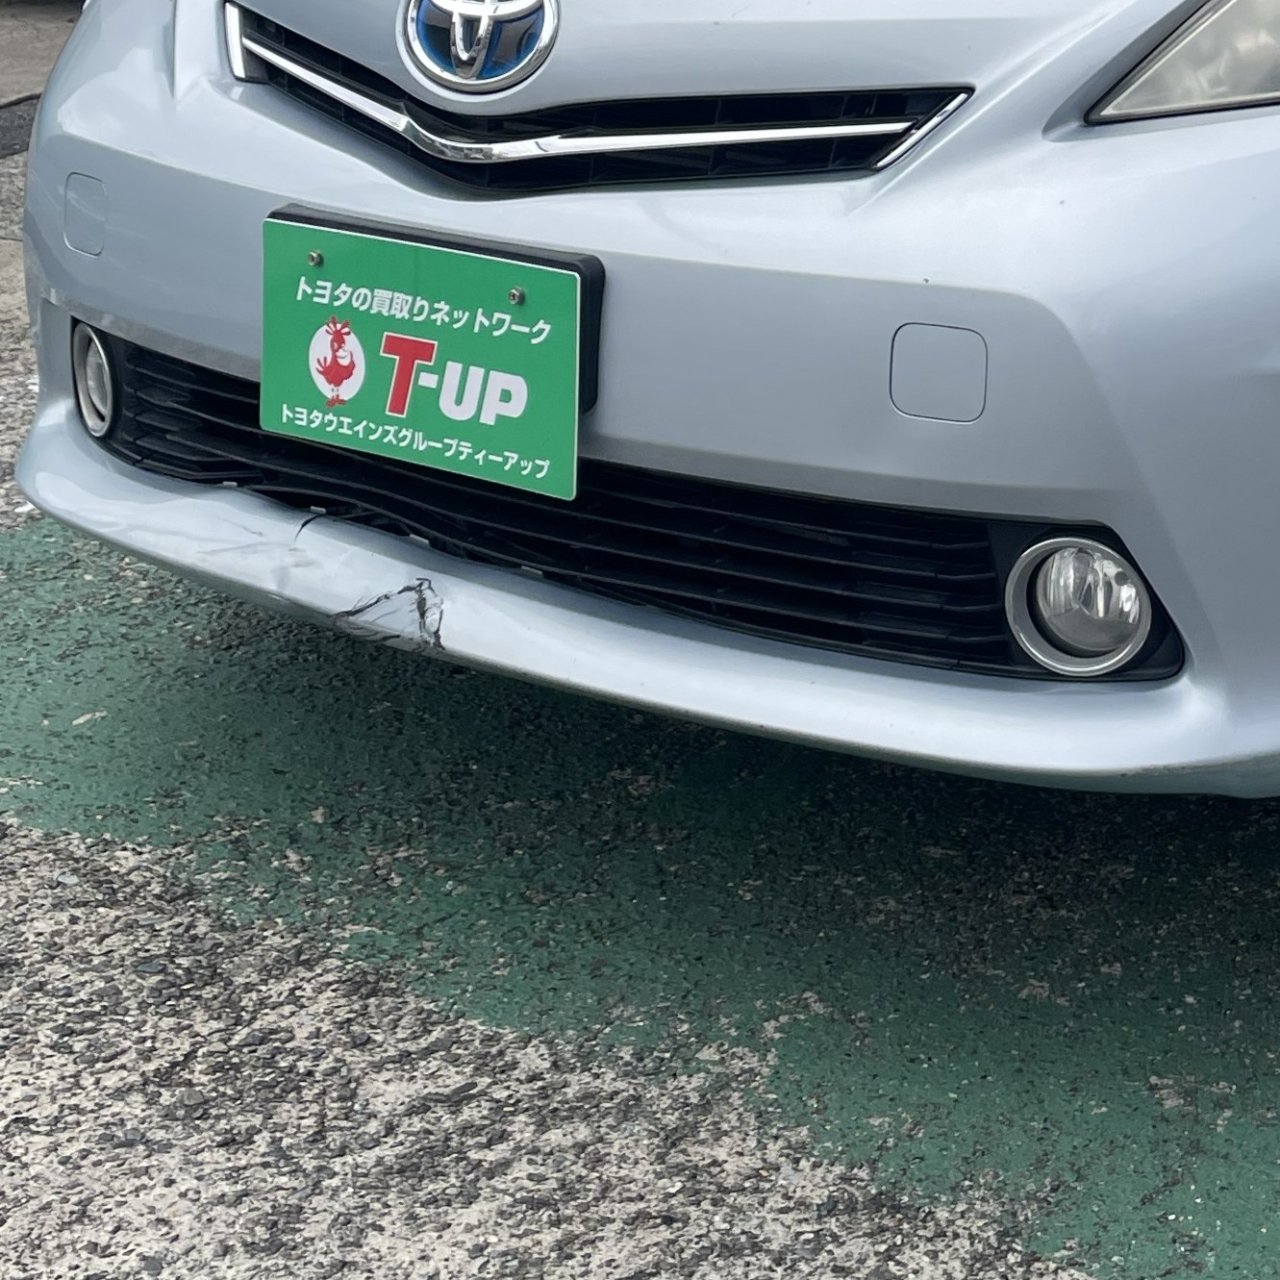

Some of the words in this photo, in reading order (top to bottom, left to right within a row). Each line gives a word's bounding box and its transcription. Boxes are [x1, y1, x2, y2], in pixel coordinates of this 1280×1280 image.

[296, 276, 551, 345] トヨタの買取りネットワーク
[380, 331, 528, 426] T-UP
[281, 403, 550, 480] トヨタウエインズグループティーアップ
